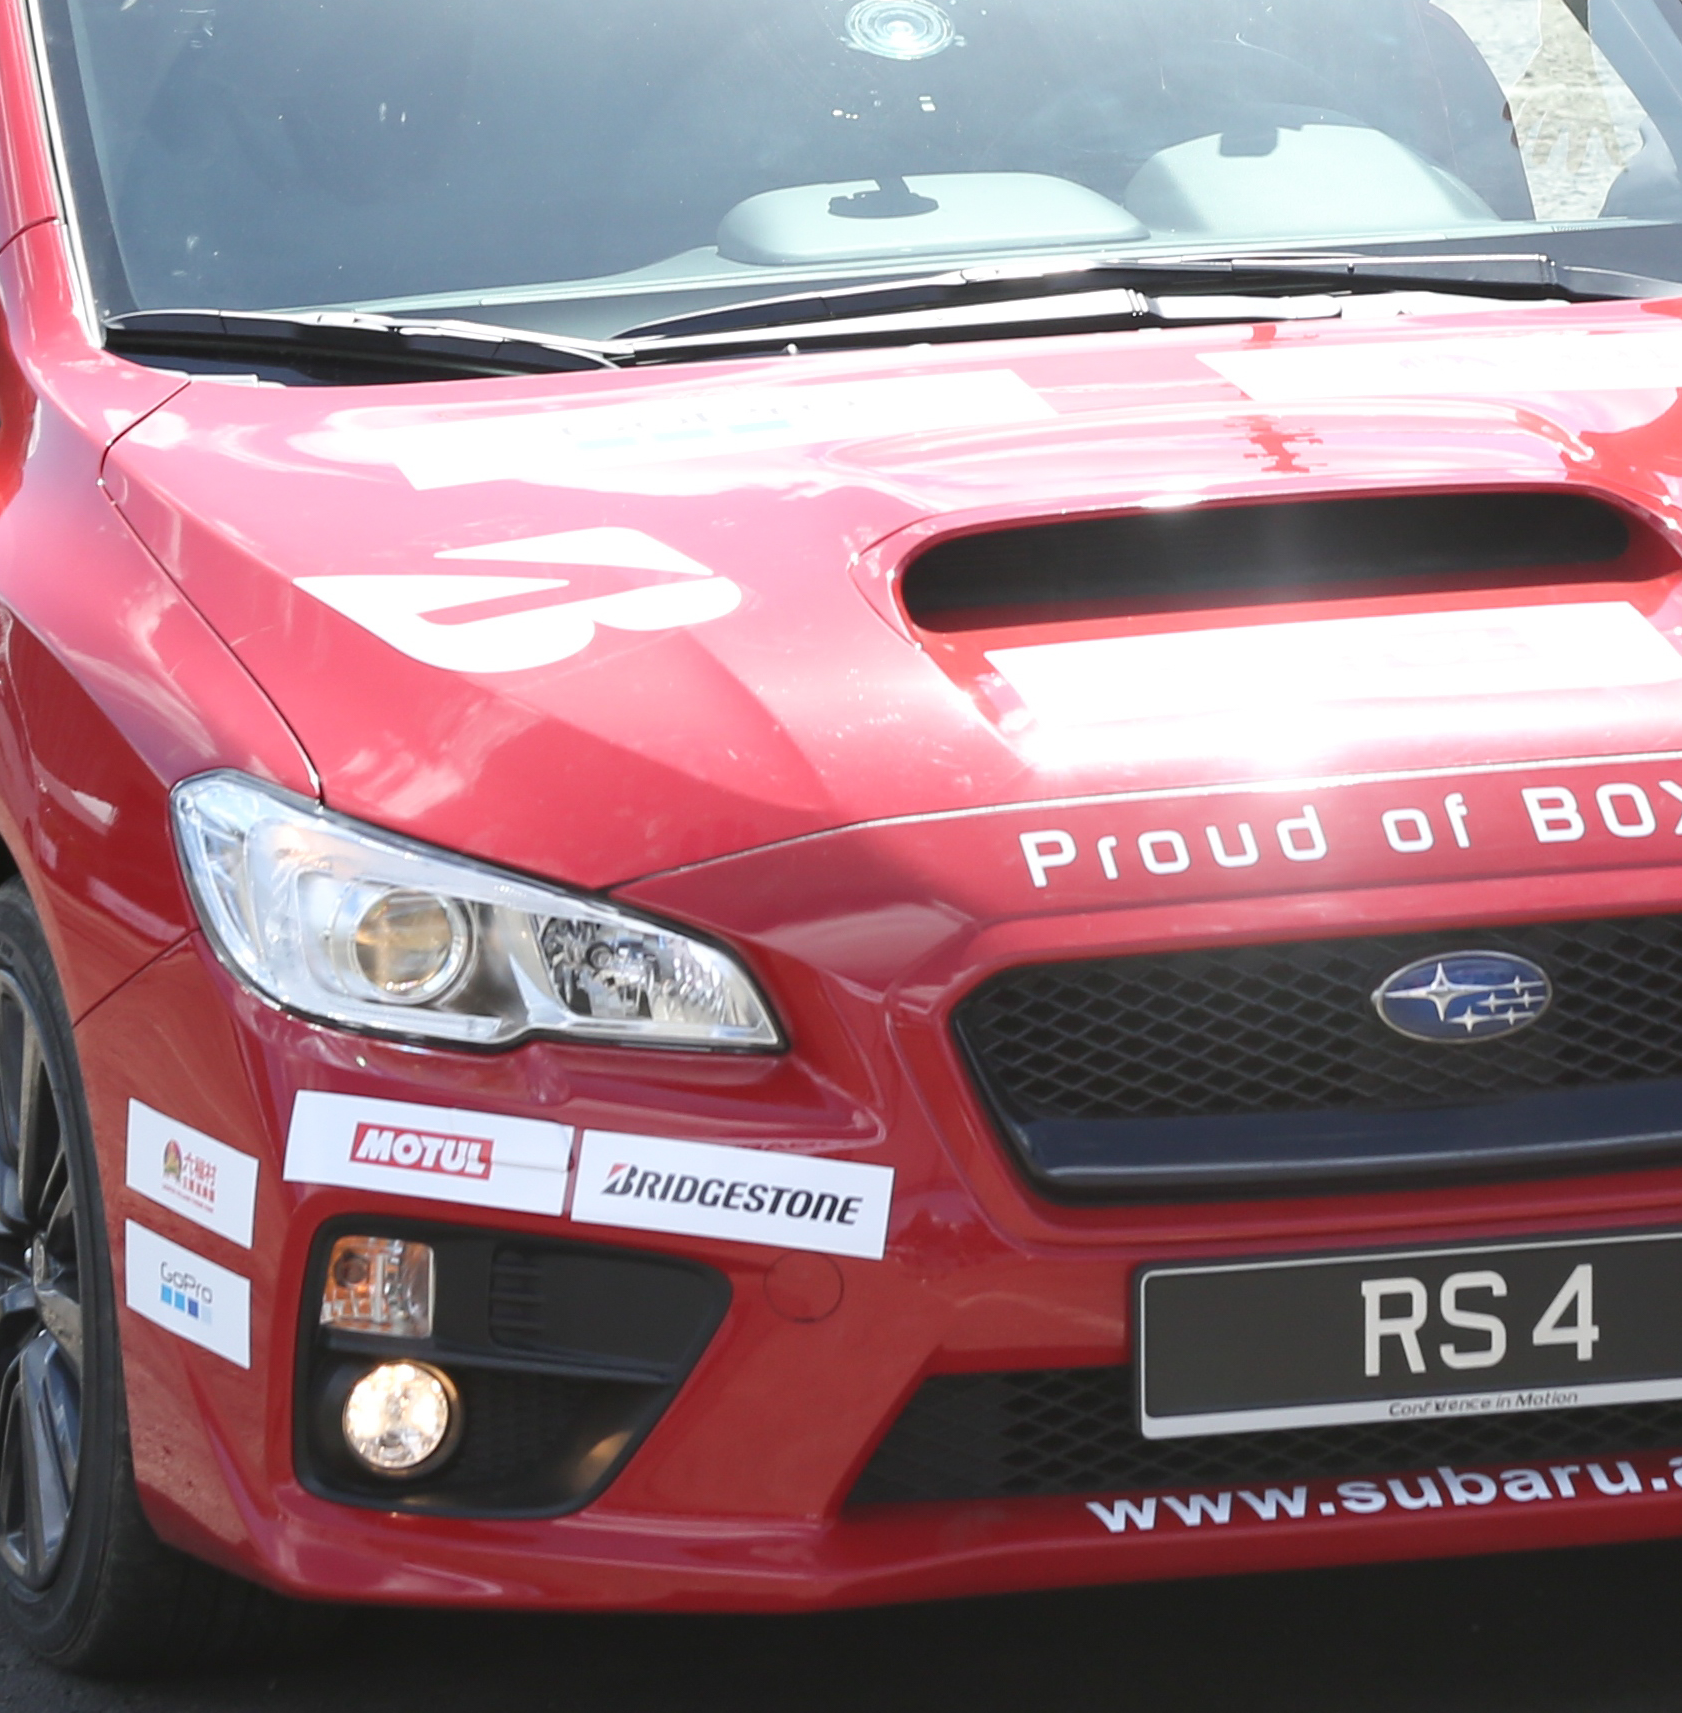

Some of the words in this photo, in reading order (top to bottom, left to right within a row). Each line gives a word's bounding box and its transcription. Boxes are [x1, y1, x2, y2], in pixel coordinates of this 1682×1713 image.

[1019, 803, 1329, 889] Proud
[1381, 793, 1471, 854] of
[354, 1128, 488, 1175] MOTUL
[600, 1162, 863, 1226] BRIDGESTONE
[160, 1261, 213, 1305] GoPro
[1361, 1269, 1508, 1378] RS
[1532, 1263, 1601, 1362] 4
[1515, 1390, 1578, 1408] Motion
